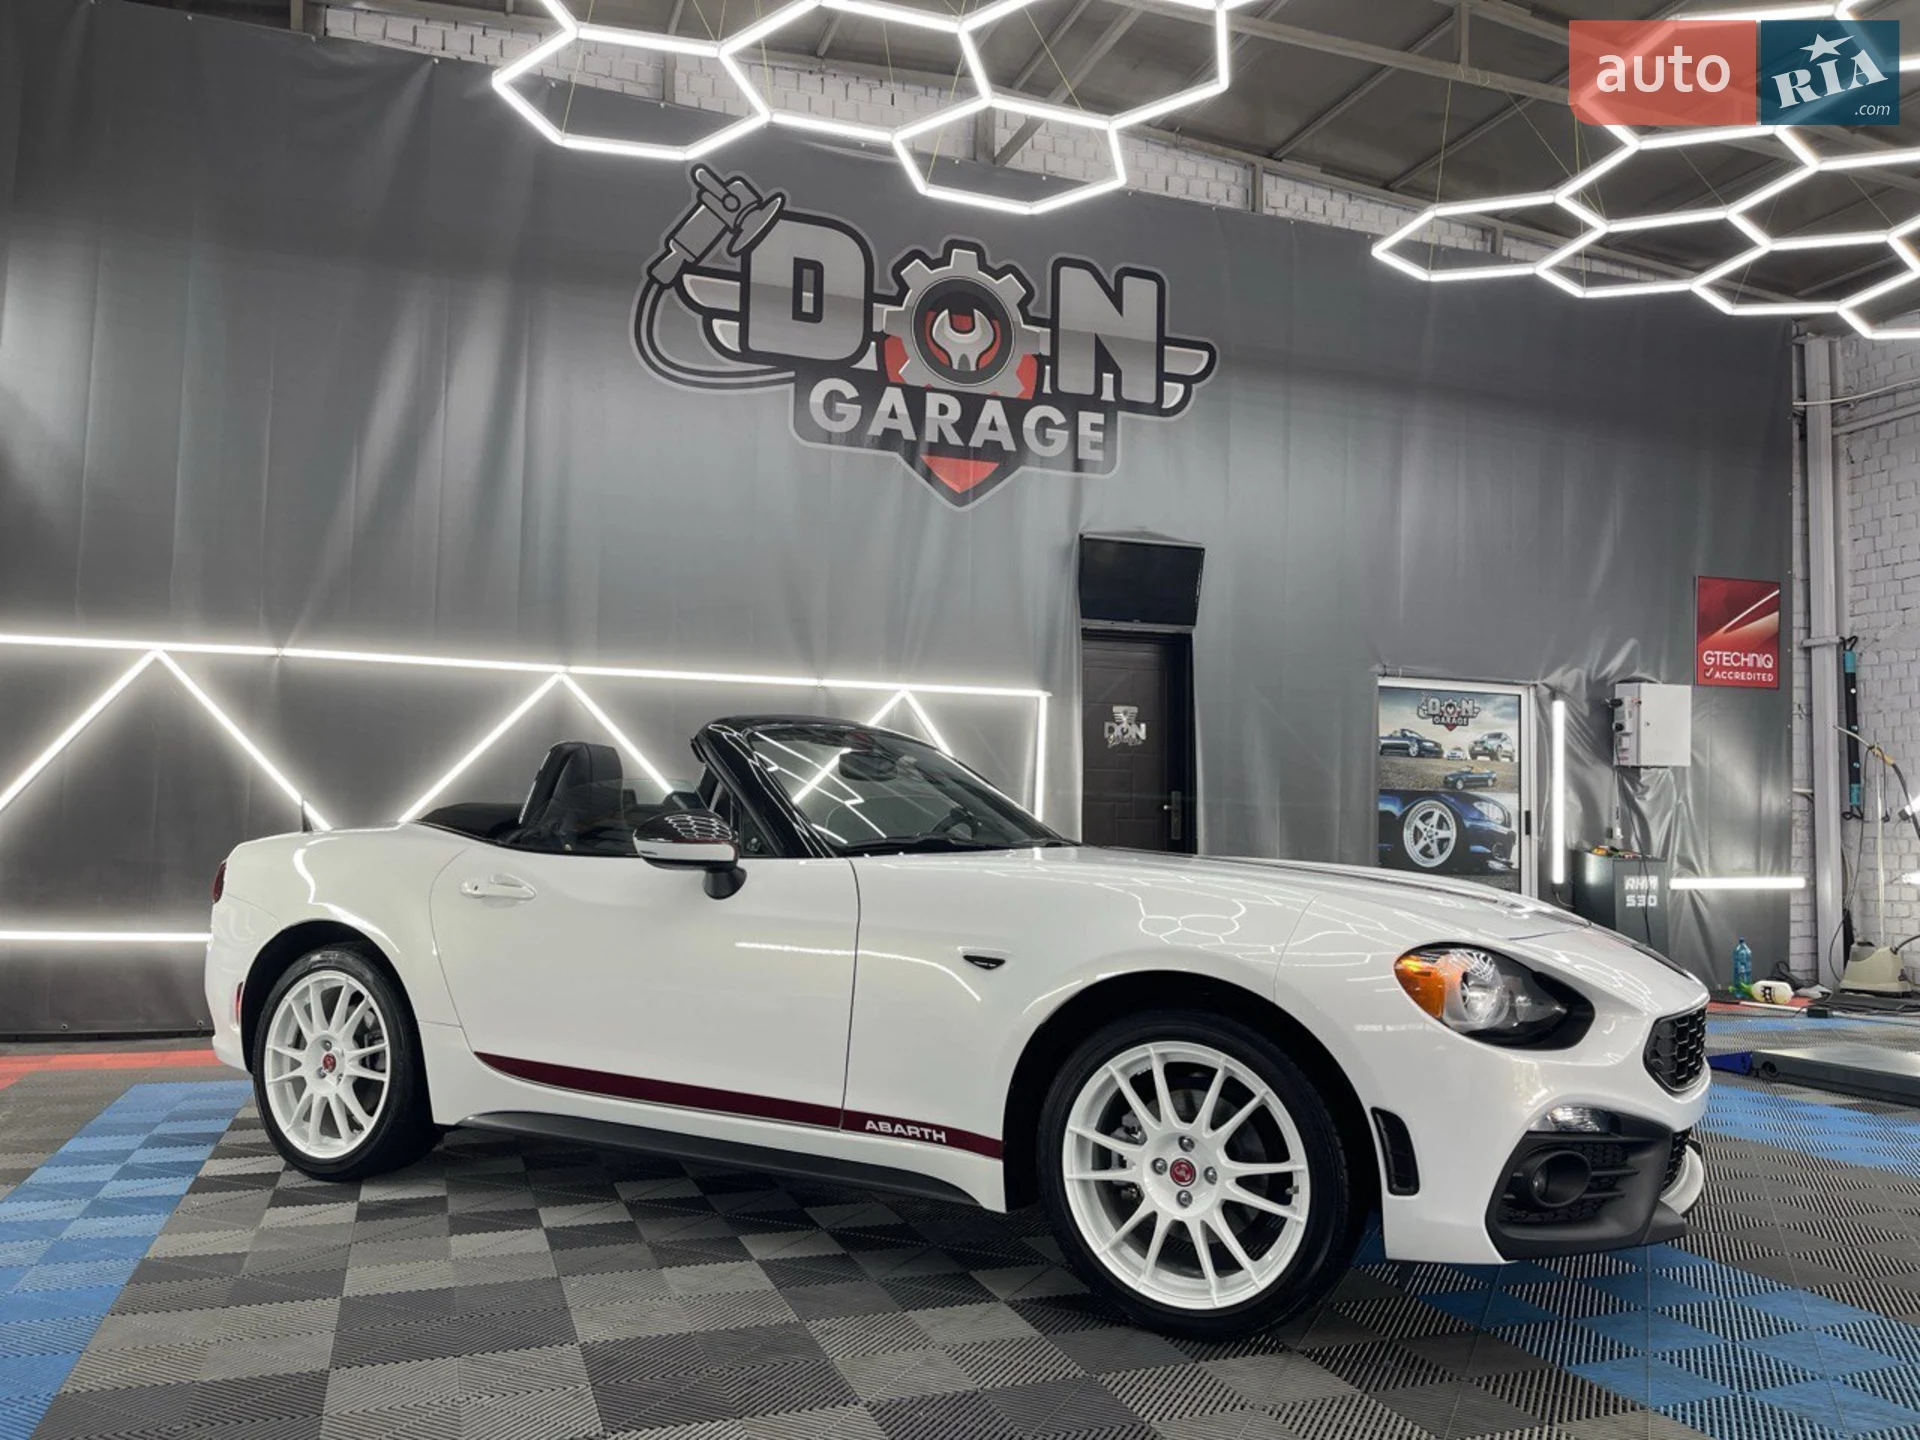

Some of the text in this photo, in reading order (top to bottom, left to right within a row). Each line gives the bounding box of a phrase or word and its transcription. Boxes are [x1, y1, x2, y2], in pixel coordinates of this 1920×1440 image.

[745, 218, 1161, 404] DON
[809, 378, 1105, 461] GARAGE
[1714, 671, 1774, 682] ACCREDITED
[1104, 721, 1146, 740] DON
[865, 1120, 946, 1143] ABARTH
